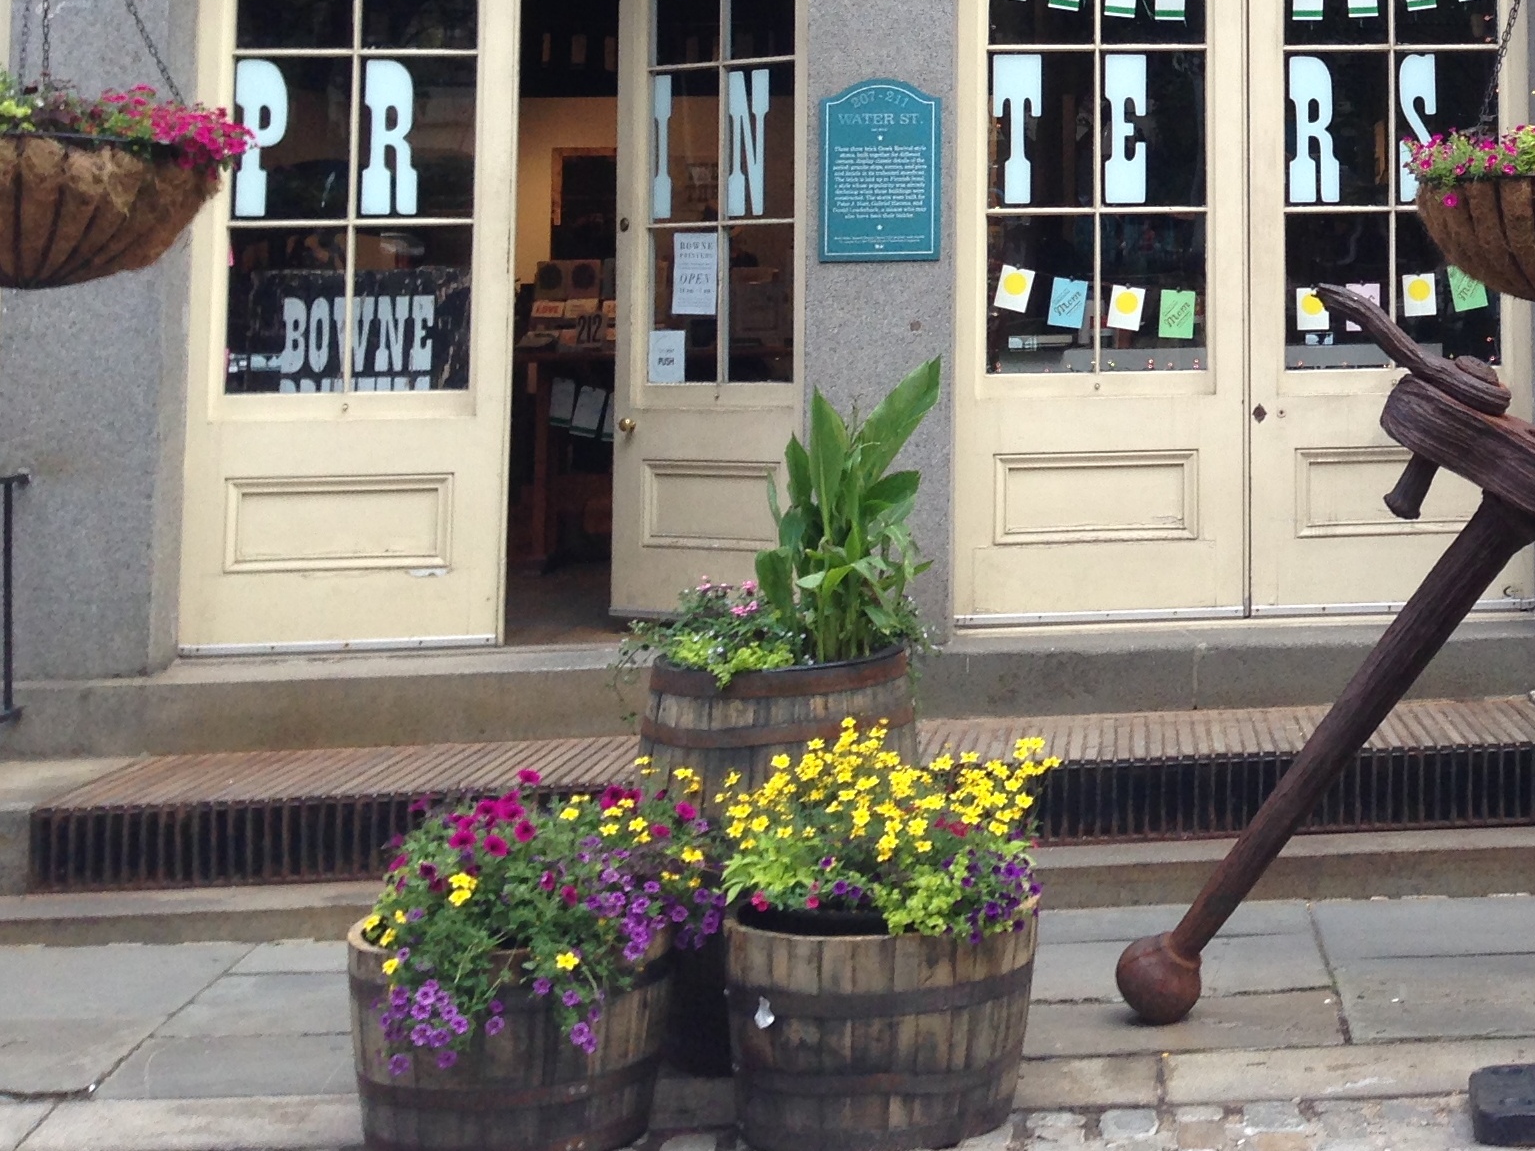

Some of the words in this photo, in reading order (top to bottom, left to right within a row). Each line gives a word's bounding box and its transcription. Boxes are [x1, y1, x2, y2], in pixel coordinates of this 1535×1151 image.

[838, 113, 895, 125] WATER
[899, 113, 924, 125] ST.
[680, 273, 711, 285] OPEN
[280, 295, 435, 374] BOWNE
[577, 314, 602, 344] 212
[658, 357, 675, 366] PUSH
